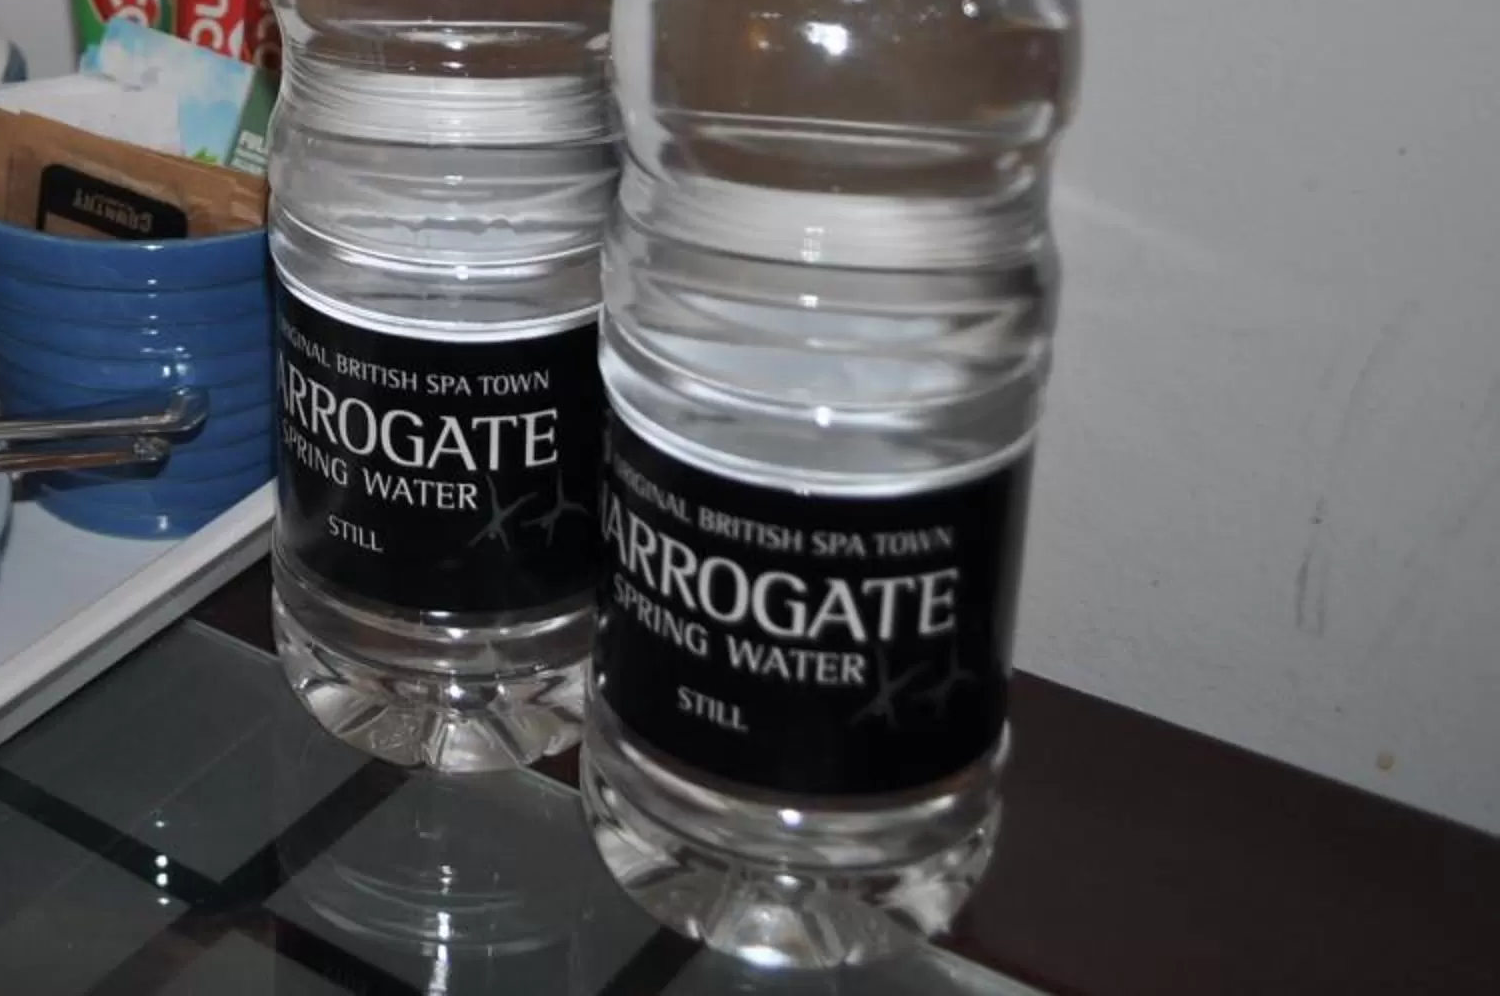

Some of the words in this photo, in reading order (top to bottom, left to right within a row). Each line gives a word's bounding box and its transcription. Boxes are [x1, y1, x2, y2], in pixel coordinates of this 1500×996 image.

[336, 352, 418, 392] BRITISH
[426, 373, 472, 397] SPA
[477, 369, 550, 397] TOWN
[276, 351, 559, 472] ARROGATE
[281, 418, 349, 487] SPRING
[362, 466, 479, 511] WATER
[327, 514, 385, 554] STILL
[698, 505, 803, 552] BRITISH
[810, 529, 867, 557] SPA
[871, 526, 955, 557] TOWN
[612, 572, 709, 657] SPRING
[726, 634, 867, 686] WATER
[676, 685, 749, 733] STILL
